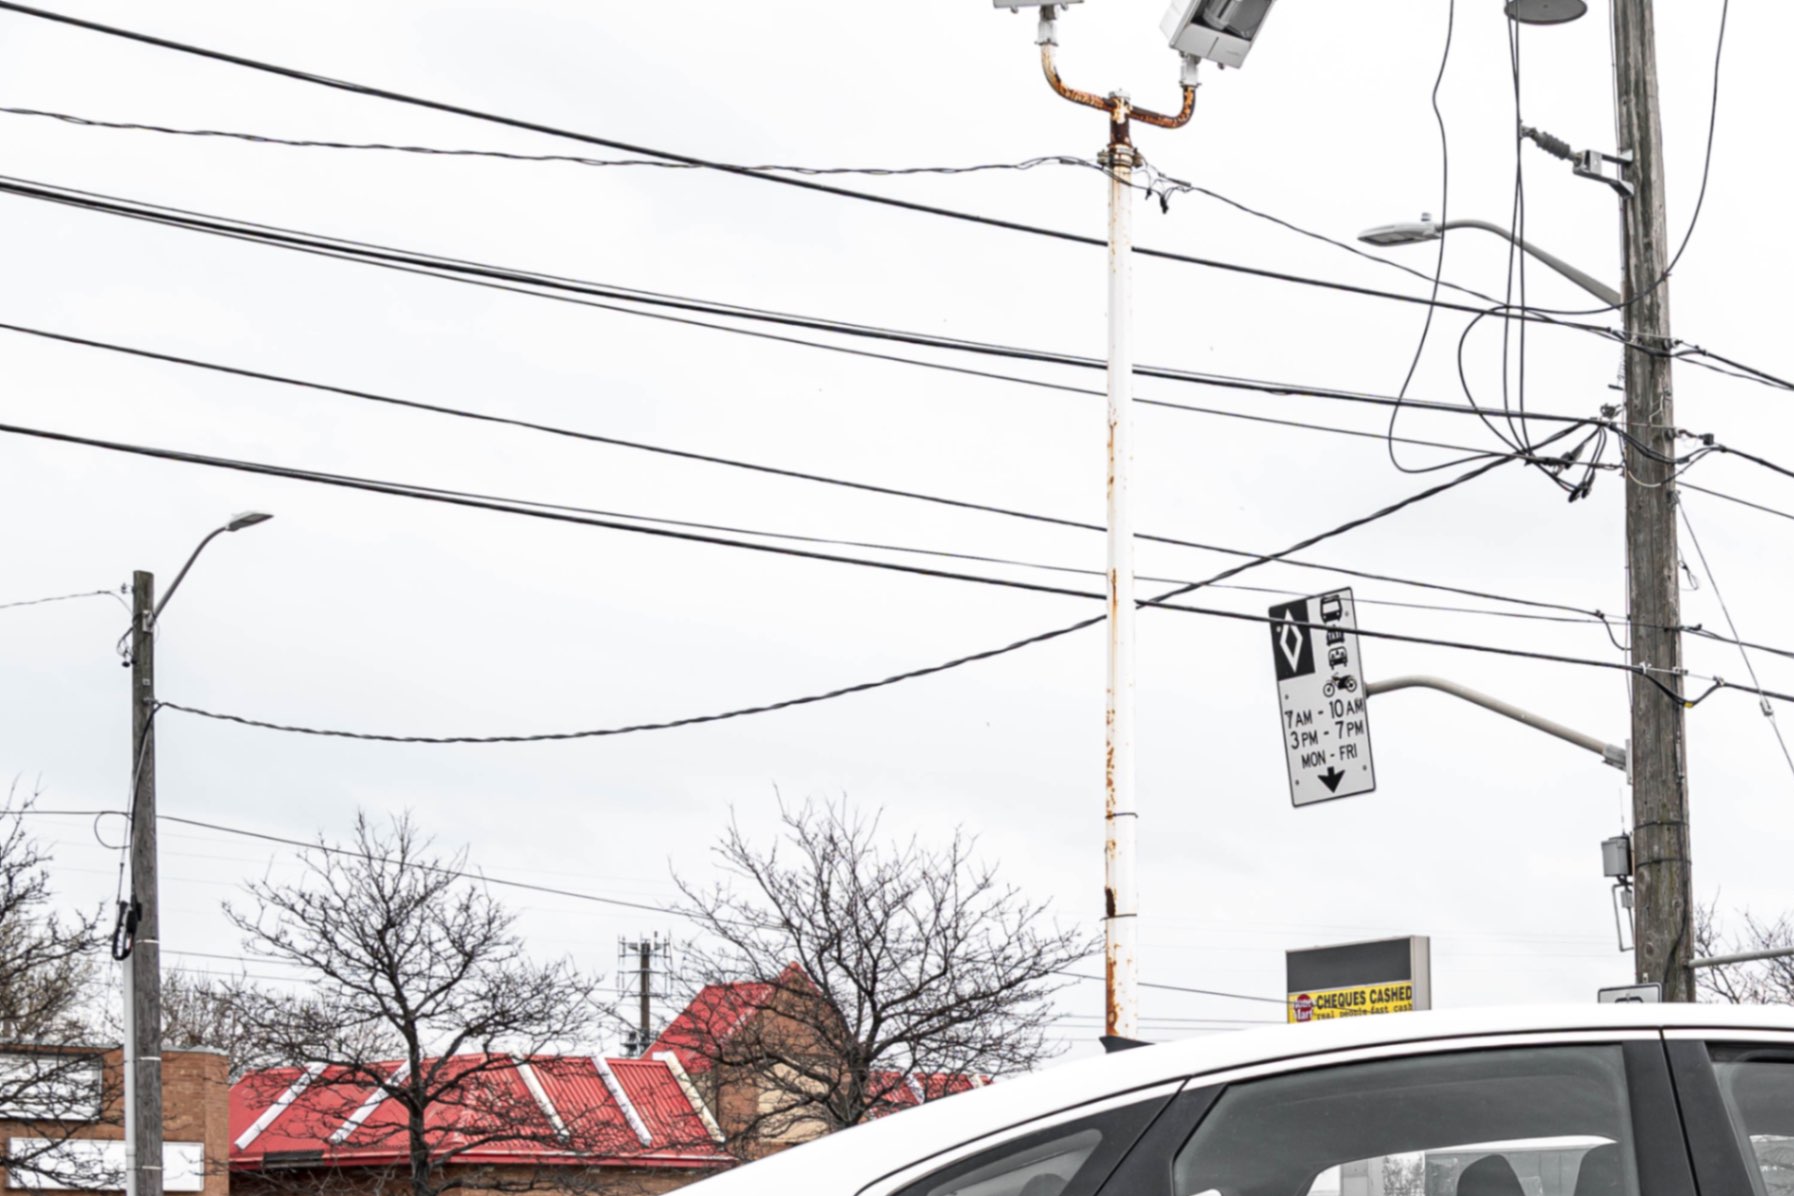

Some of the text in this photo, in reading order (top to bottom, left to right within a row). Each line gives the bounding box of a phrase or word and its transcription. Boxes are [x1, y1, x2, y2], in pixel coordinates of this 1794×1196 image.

[1301, 749, 1326, 769] MON
[1339, 743, 1358, 761] FRI
[1316, 990, 1366, 1009] CHEQUES
[1369, 986, 1413, 1004] CASHED
